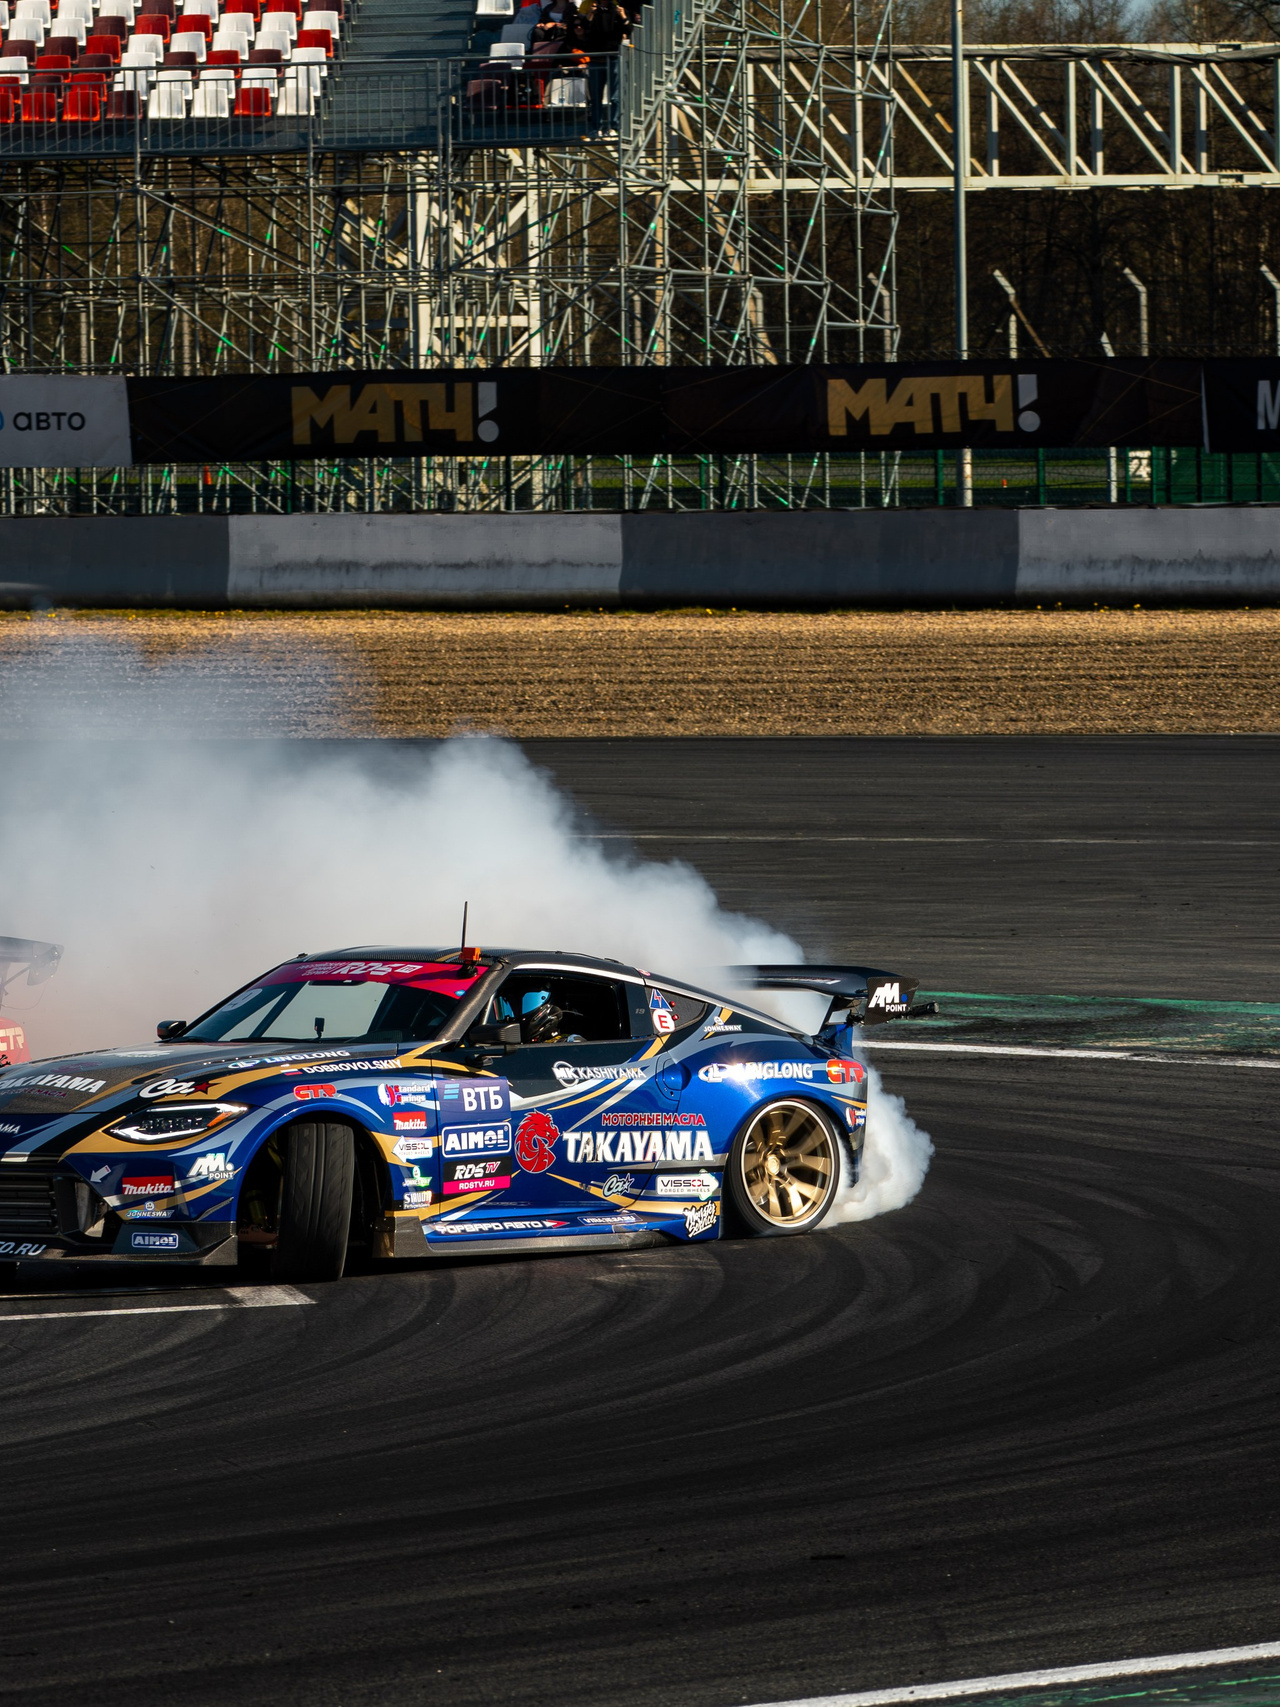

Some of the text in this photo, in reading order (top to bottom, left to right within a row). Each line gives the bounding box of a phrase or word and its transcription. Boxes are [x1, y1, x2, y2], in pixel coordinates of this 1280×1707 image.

[13, 409, 86, 432] авто
[885, 1004, 907, 1012] POINT
[658, 1015, 670, 1029] E
[264, 1050, 351, 1063] LINGLONG
[302, 1059, 403, 1074] DOBROVOLSKIY
[578, 1067, 647, 1079] KASHIYAMA
[734, 1062, 813, 1080] NGLONG
[293, 1084, 336, 1100] CTR
[394, 1082, 431, 1093] Standard
[396, 1094, 426, 1104] Springs
[462, 1086, 503, 1111] ВТБ
[601, 1113, 706, 1126] МОТОРНЫЕ МАСЛА
[445, 1129, 508, 1151] AIMOL
[562, 1131, 715, 1163] TAKAYAMA
[208, 1172, 234, 1180] POINT
[454, 1161, 501, 1180] RDS TV
[459, 1180, 495, 1190] RDSTV.RU
[661, 1179, 710, 1187] VISSOL
[126, 1210, 174, 1218] JONNESWAY
[503, 1220, 543, 1230] АВТО
[134, 1235, 176, 1245] AIMOL
